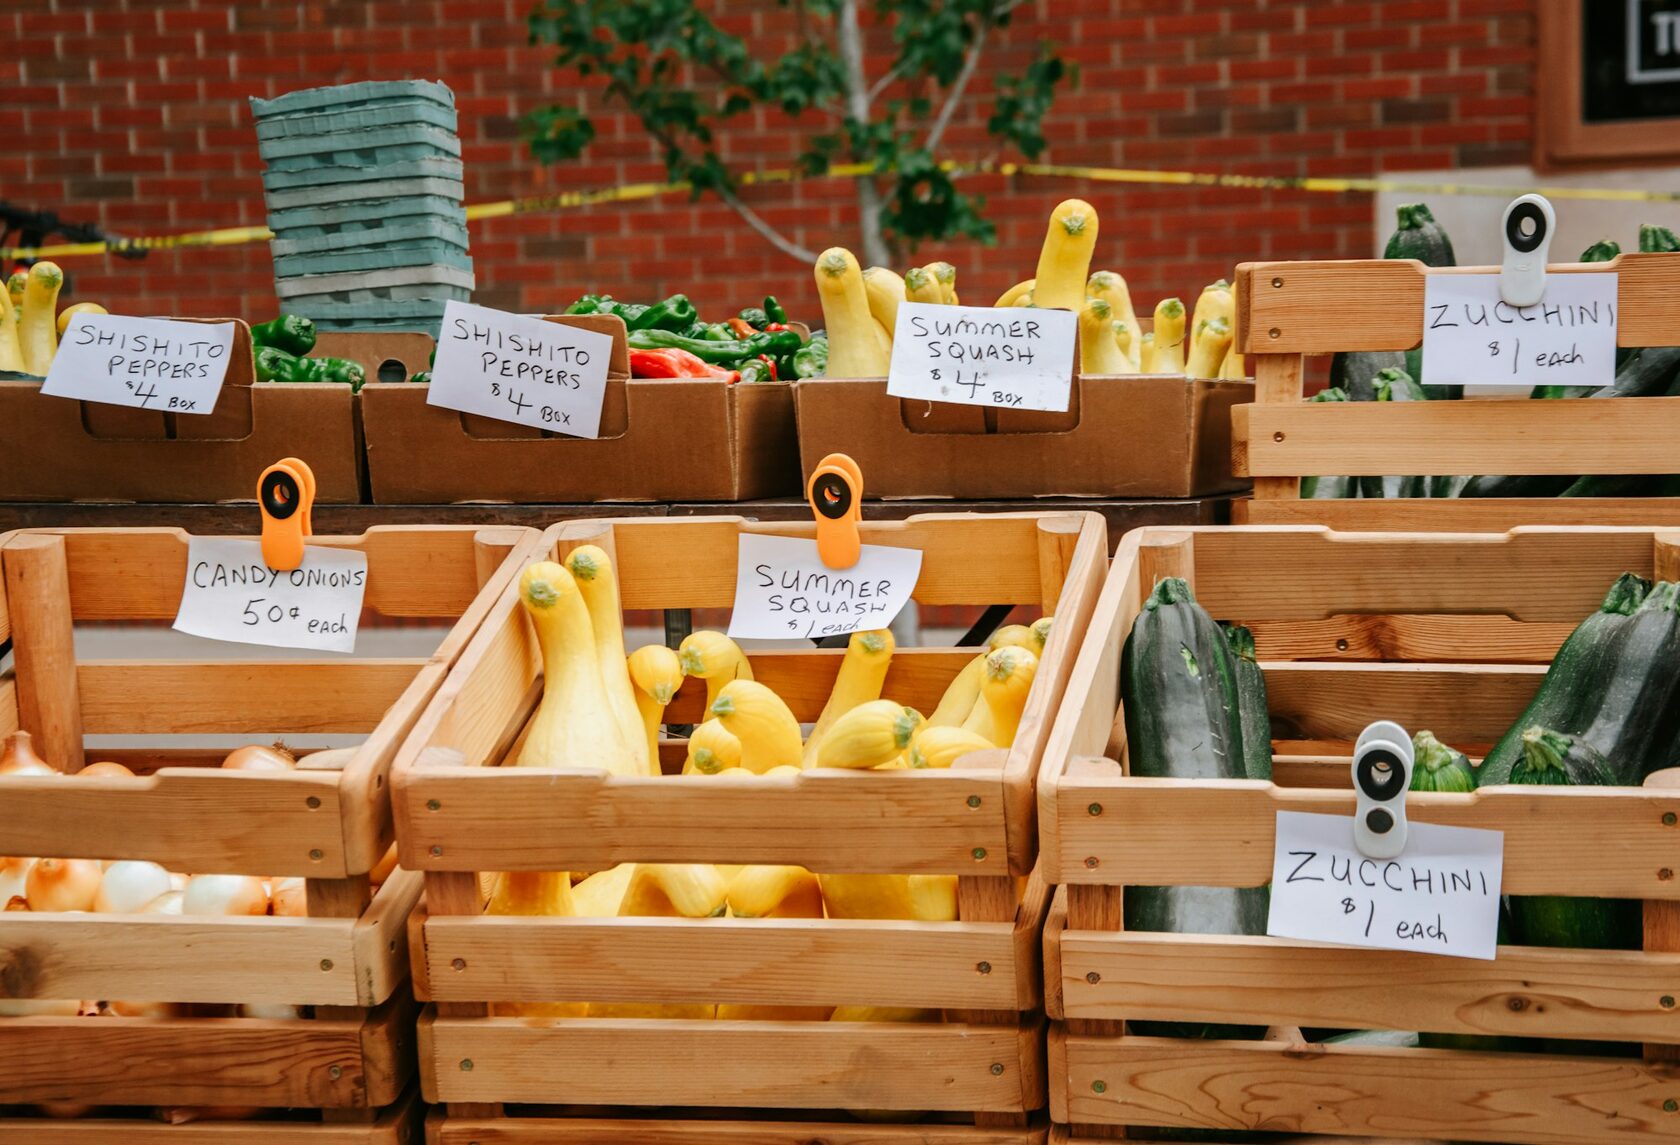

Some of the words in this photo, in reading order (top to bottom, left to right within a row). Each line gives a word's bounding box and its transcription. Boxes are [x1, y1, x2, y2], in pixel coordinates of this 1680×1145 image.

[911, 316, 1041, 339] SUMMER
[1429, 300, 1615, 330] ZUCCHINI
[75, 324, 224, 359] SHISHITO
[453, 318, 590, 366] SHISHITO
[927, 341, 1035, 365] SQUASH
[1487, 338, 1520, 375] $1
[1535, 342, 1585, 368] each
[108, 355, 210, 379] PEPPERS
[481, 351, 581, 390] PEPPERS
[125, 380, 159, 409] $4
[168, 396, 197, 411] BOX
[491, 382, 533, 416] $4
[540, 405, 571, 426] BOX
[930, 368, 986, 399] $4
[992, 391, 1024, 407] BOX
[193, 561, 280, 589] CANDY
[289, 568, 366, 589] ONIONS
[755, 563, 892, 599] SUMMER
[242, 598, 301, 626] 50¢
[307, 612, 349, 635] each
[768, 594, 887, 616] SQUASH
[787, 618, 816, 639] $1
[821, 616, 863, 635] each
[1286, 850, 1488, 896] ZUCCHINI
[1340, 897, 1376, 938] $1
[1396, 913, 1448, 944] each
